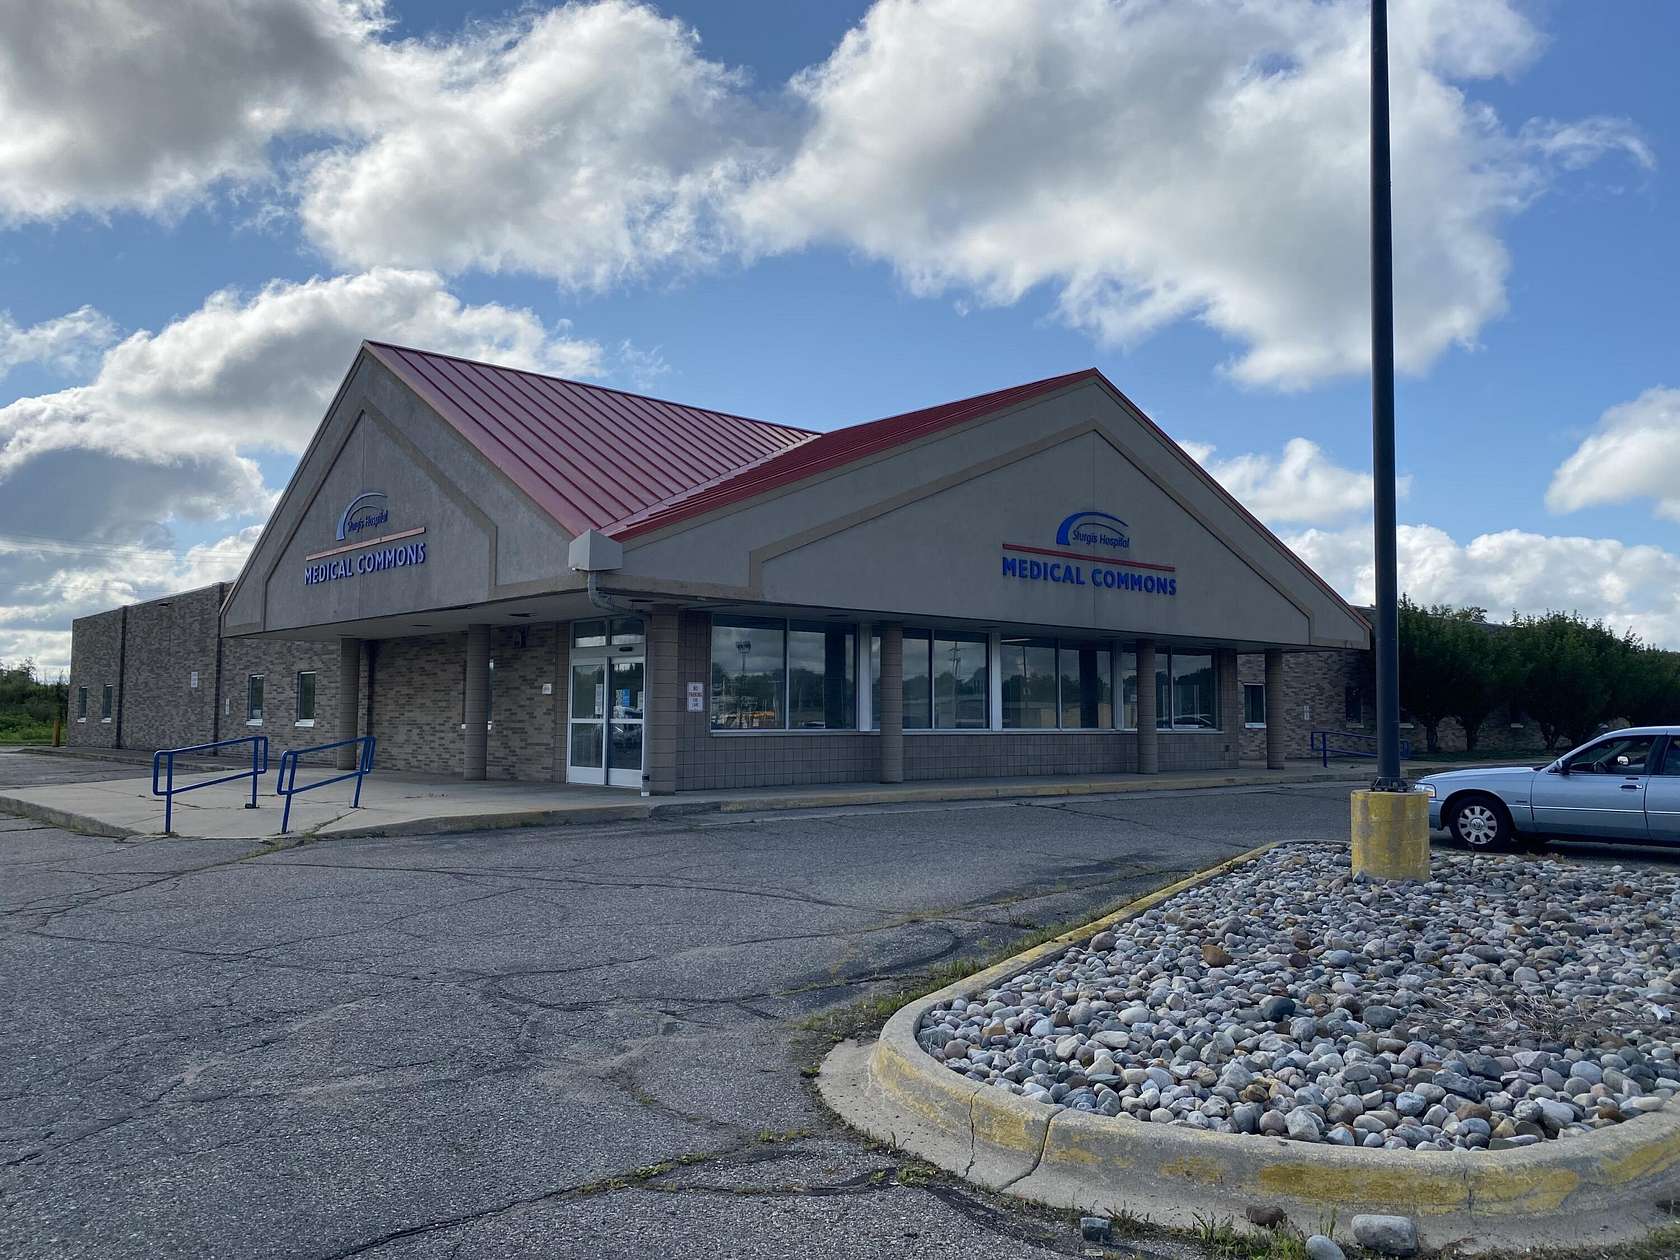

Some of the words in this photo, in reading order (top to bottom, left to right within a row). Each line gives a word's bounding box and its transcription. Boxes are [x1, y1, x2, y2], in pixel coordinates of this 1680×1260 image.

[1072, 529, 1098, 545] Sturgis
[1099, 534, 1130, 549] Hospital
[304, 558, 354, 585] MEDICAL
[357, 543, 426, 575] COMMONS
[1002, 556, 1086, 585] MEDICAL
[1091, 568, 1177, 596] COMMONS
